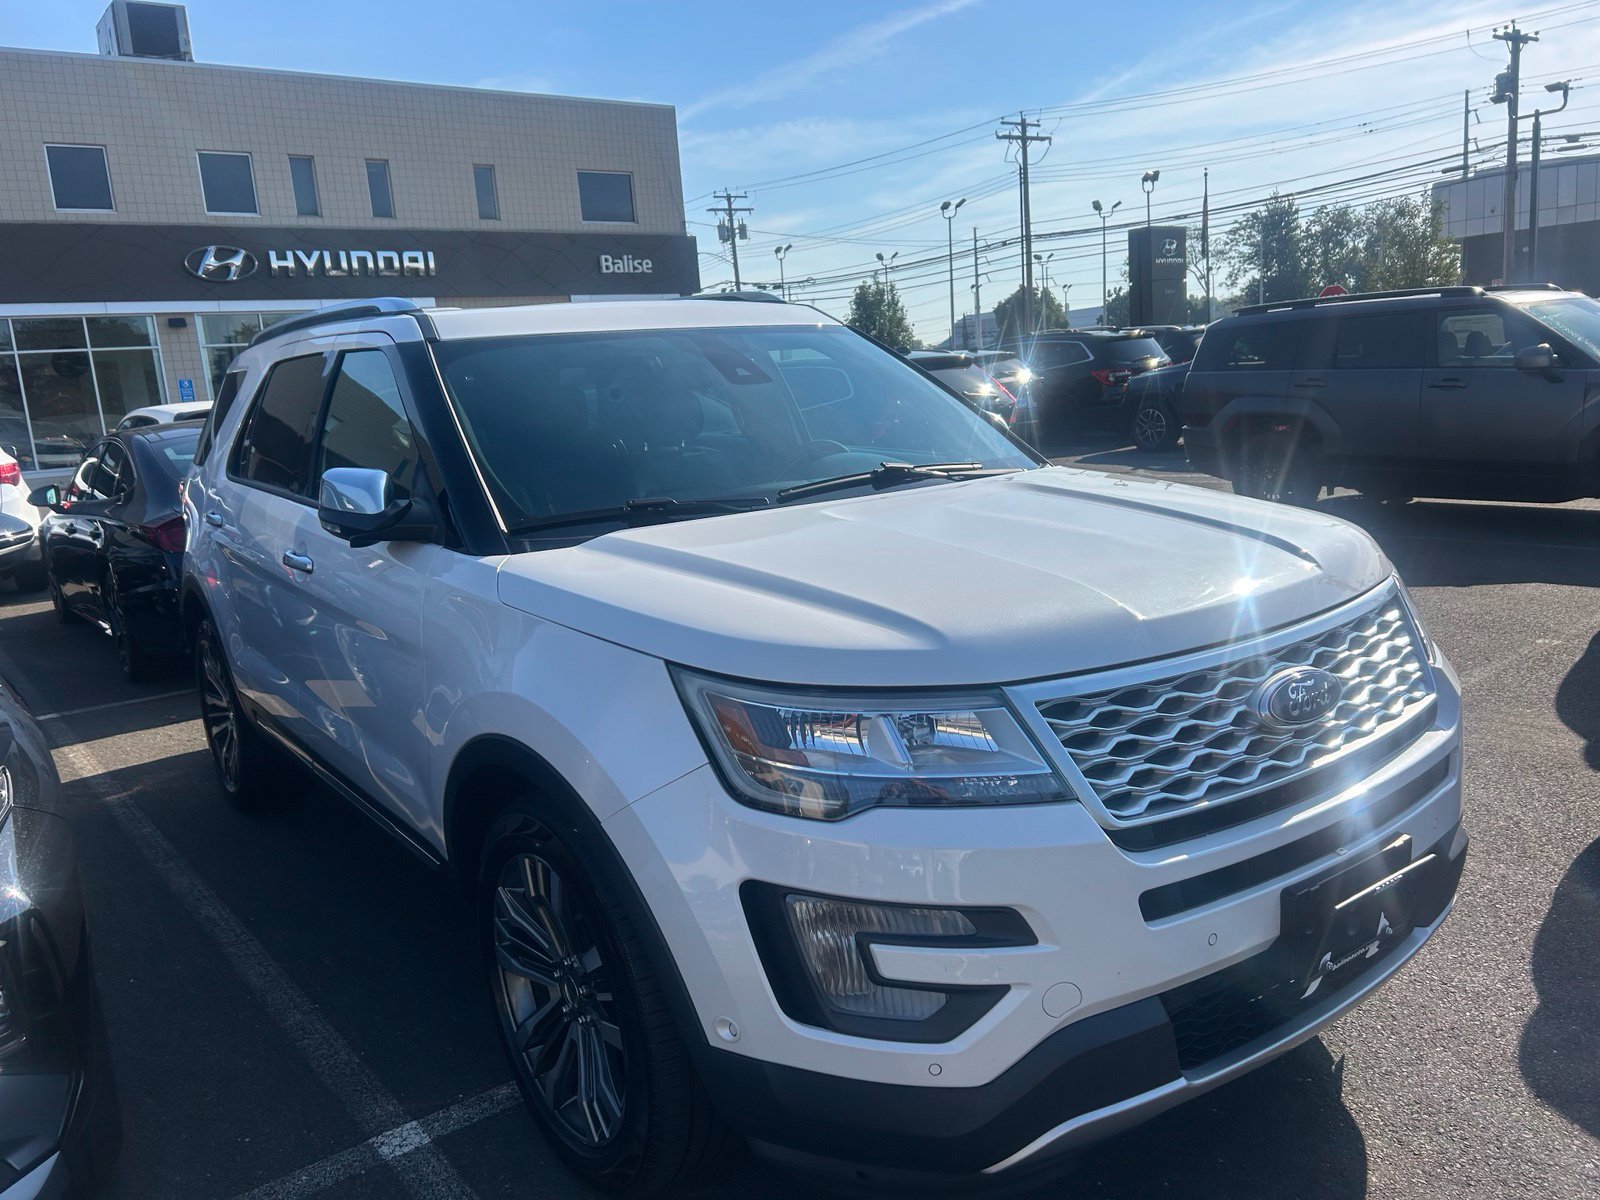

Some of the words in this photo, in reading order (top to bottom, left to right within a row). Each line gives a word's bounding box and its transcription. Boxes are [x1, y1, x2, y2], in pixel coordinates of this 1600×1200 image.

[268, 250, 437, 277] HYUNDAI
[600, 254, 653, 274] Balise
[1287, 678, 1332, 717] Ford
